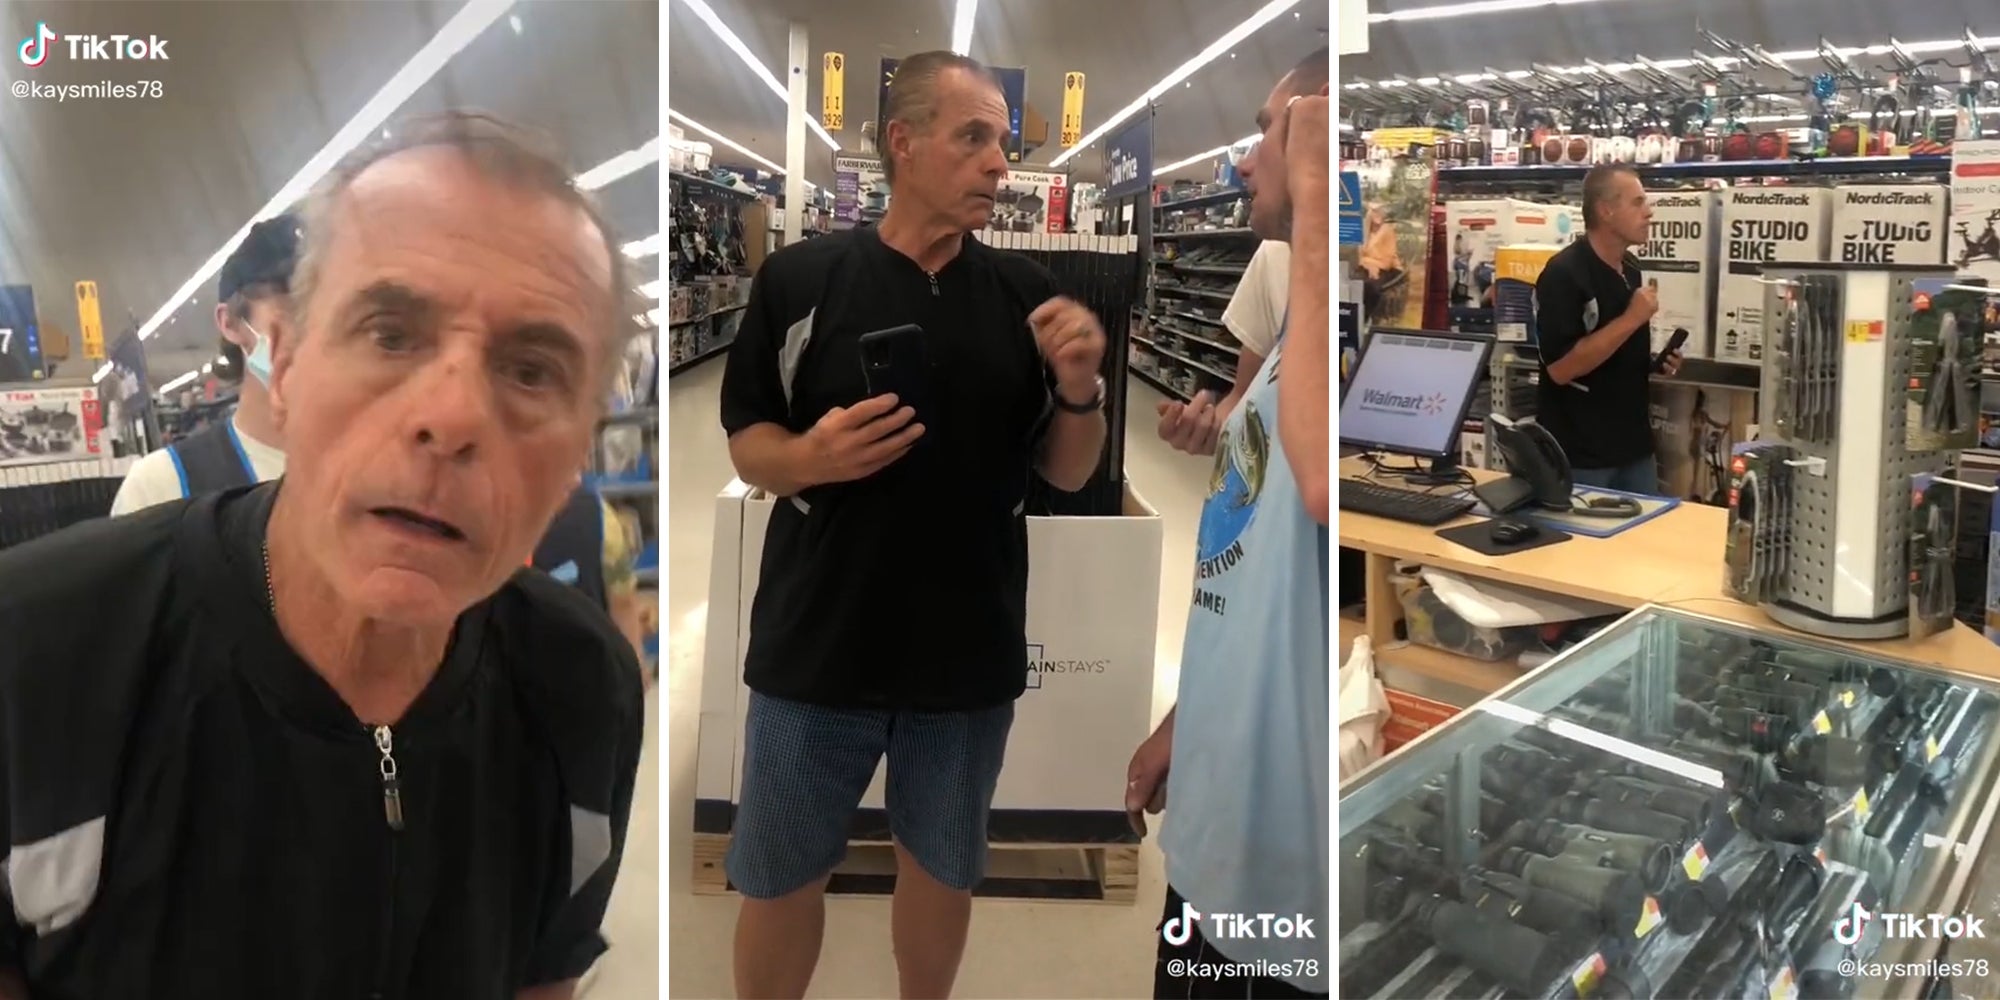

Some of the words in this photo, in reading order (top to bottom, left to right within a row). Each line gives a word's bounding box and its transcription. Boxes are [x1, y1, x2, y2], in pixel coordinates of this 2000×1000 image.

[833, 114, 843, 127] 29
[1062, 131, 1072, 144] 30
[1732, 192, 1810, 206] NordicTrack
[1846, 191, 1934, 205] NordicTrack
[1649, 220, 1702, 240] TUDIO
[1730, 219, 1809, 242] STUDIO
[1729, 240, 1777, 261] BIKE
[1842, 242, 1896, 263] BIKE
[1363, 387, 1424, 410] Walmart
[1196, 540, 1245, 580] ENTION
[1193, 587, 1227, 616] AME!
[1027, 660, 1105, 674] AINSTAYS
